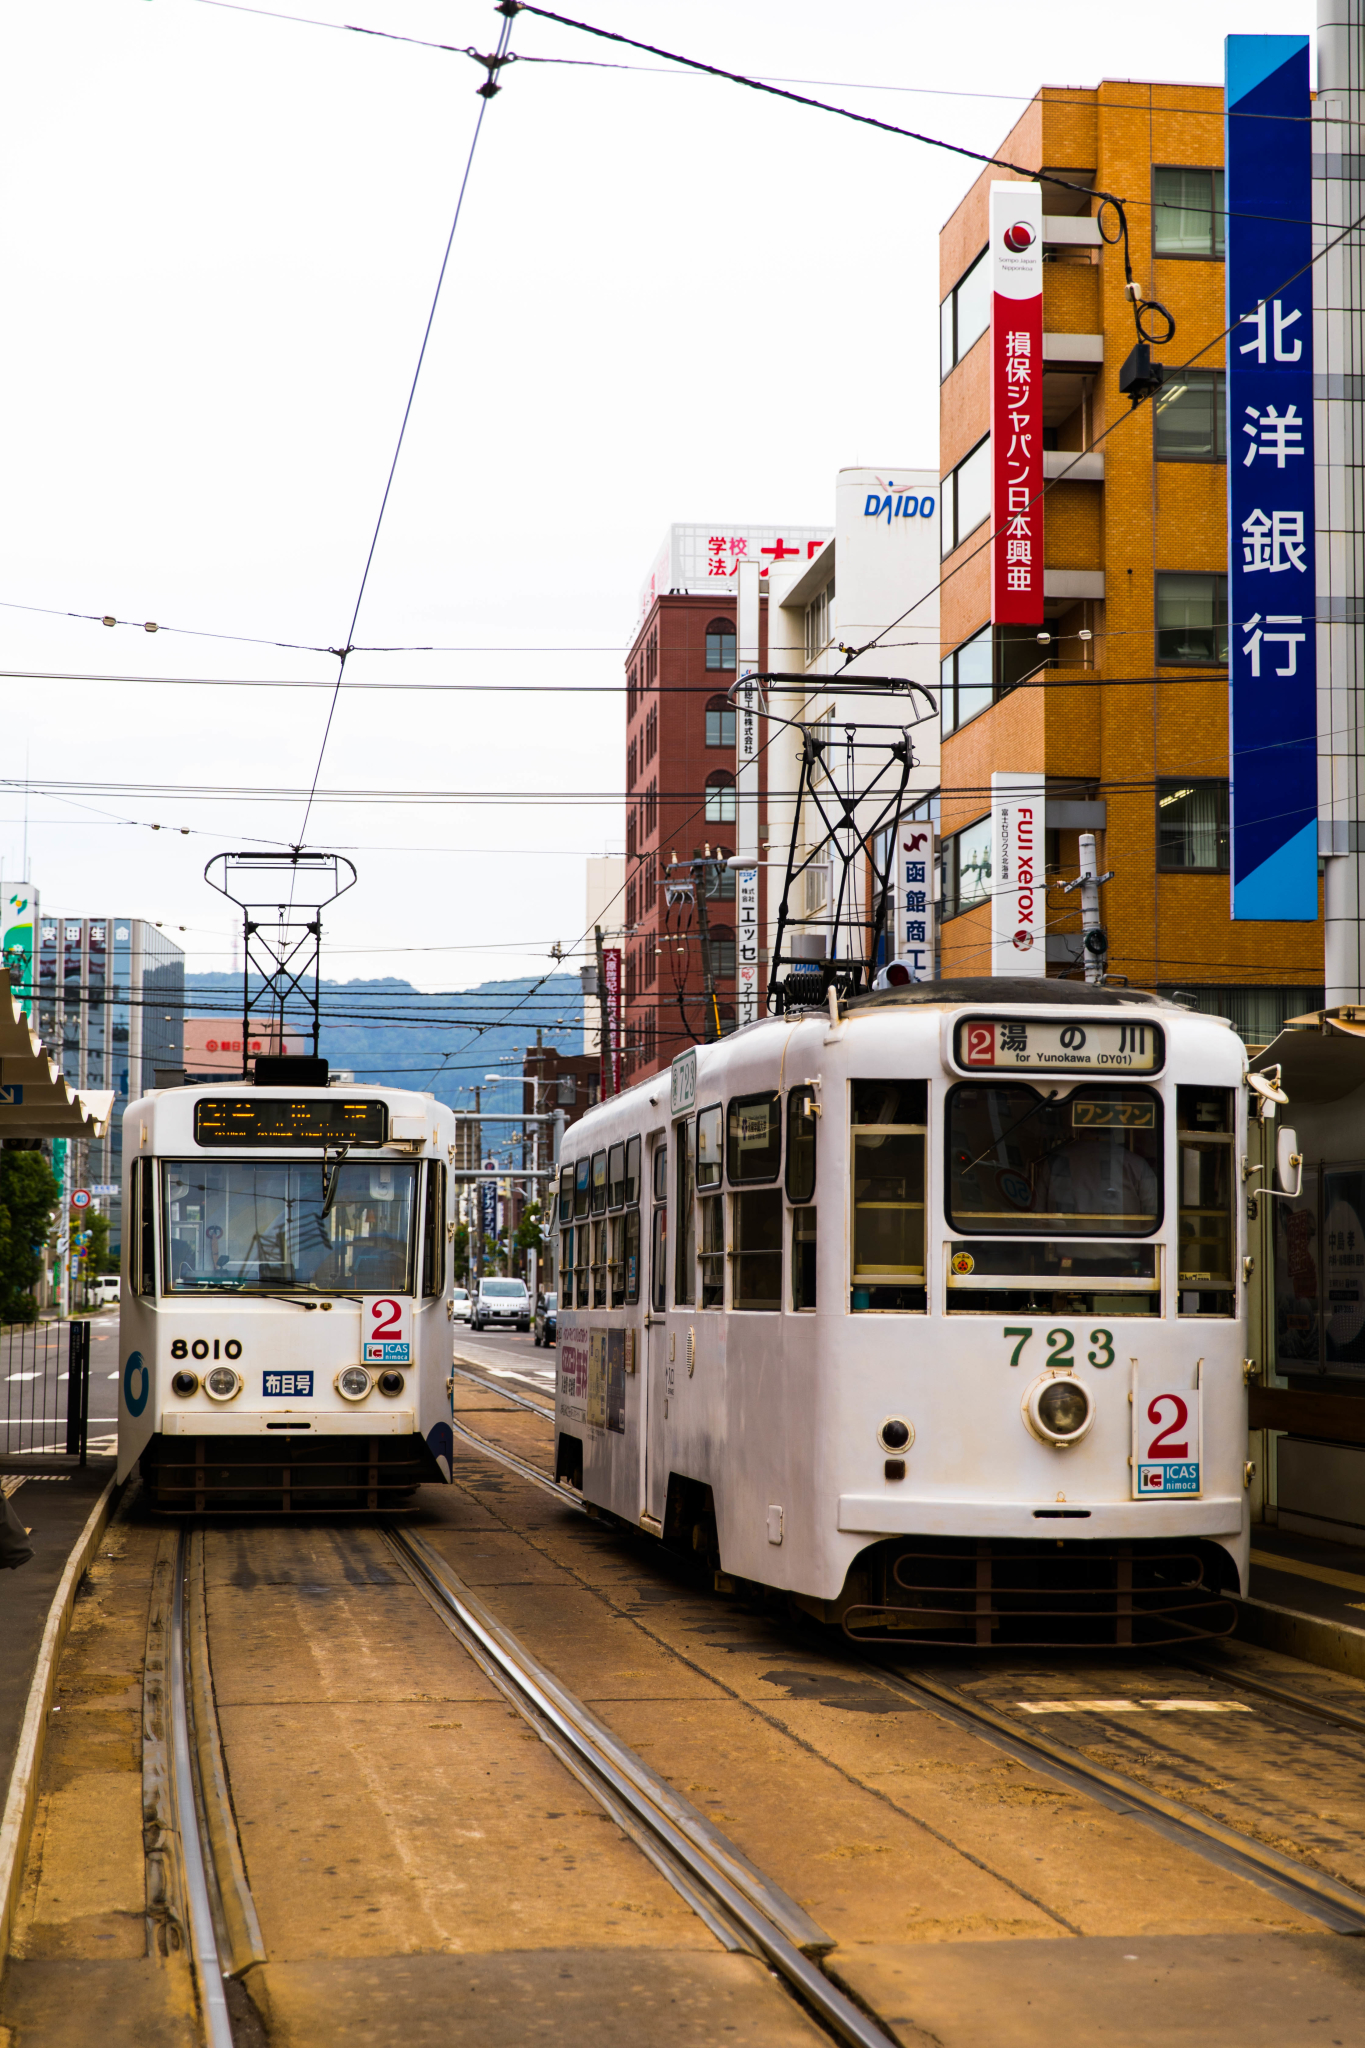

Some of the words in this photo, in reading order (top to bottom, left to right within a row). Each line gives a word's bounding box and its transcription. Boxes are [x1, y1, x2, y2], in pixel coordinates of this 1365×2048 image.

[1005, 331, 1033, 591] 損保ジャパン日本興亜
[1239, 299, 1308, 677] 北洋銀行
[864, 494, 936, 525] DAIDO
[708, 536, 748, 556] 学校
[1001, 808, 1010, 880] 富士ゼロックス北海道
[1017, 808, 1034, 851] FUJI
[1017, 856, 1034, 924] xerox
[42, 926, 130, 942] 安田生命
[740, 907, 757, 961] エッセ
[970, 1029, 992, 1060] 2
[1000, 1024, 1146, 1055] 湯の川
[1015, 1053, 1031, 1063] for
[1036, 1052, 1092, 1064] Yunokawa
[1097, 1053, 1133, 1066] (DY01)
[680, 1060, 695, 1103] 723
[1076, 1104, 1152, 1125] ワンマン
[76, 1195, 88, 1204] 40
[371, 1298, 402, 1340] 2
[171, 1339, 243, 1360] 8010
[385, 1344, 408, 1353] ICAS
[1003, 1327, 1115, 1369] 723
[265, 1374, 311, 1394] 布目号
[1147, 1394, 1189, 1459] 2
[1166, 1465, 1197, 1479] ICAS
[1166, 1480, 1197, 1490] nimoca
